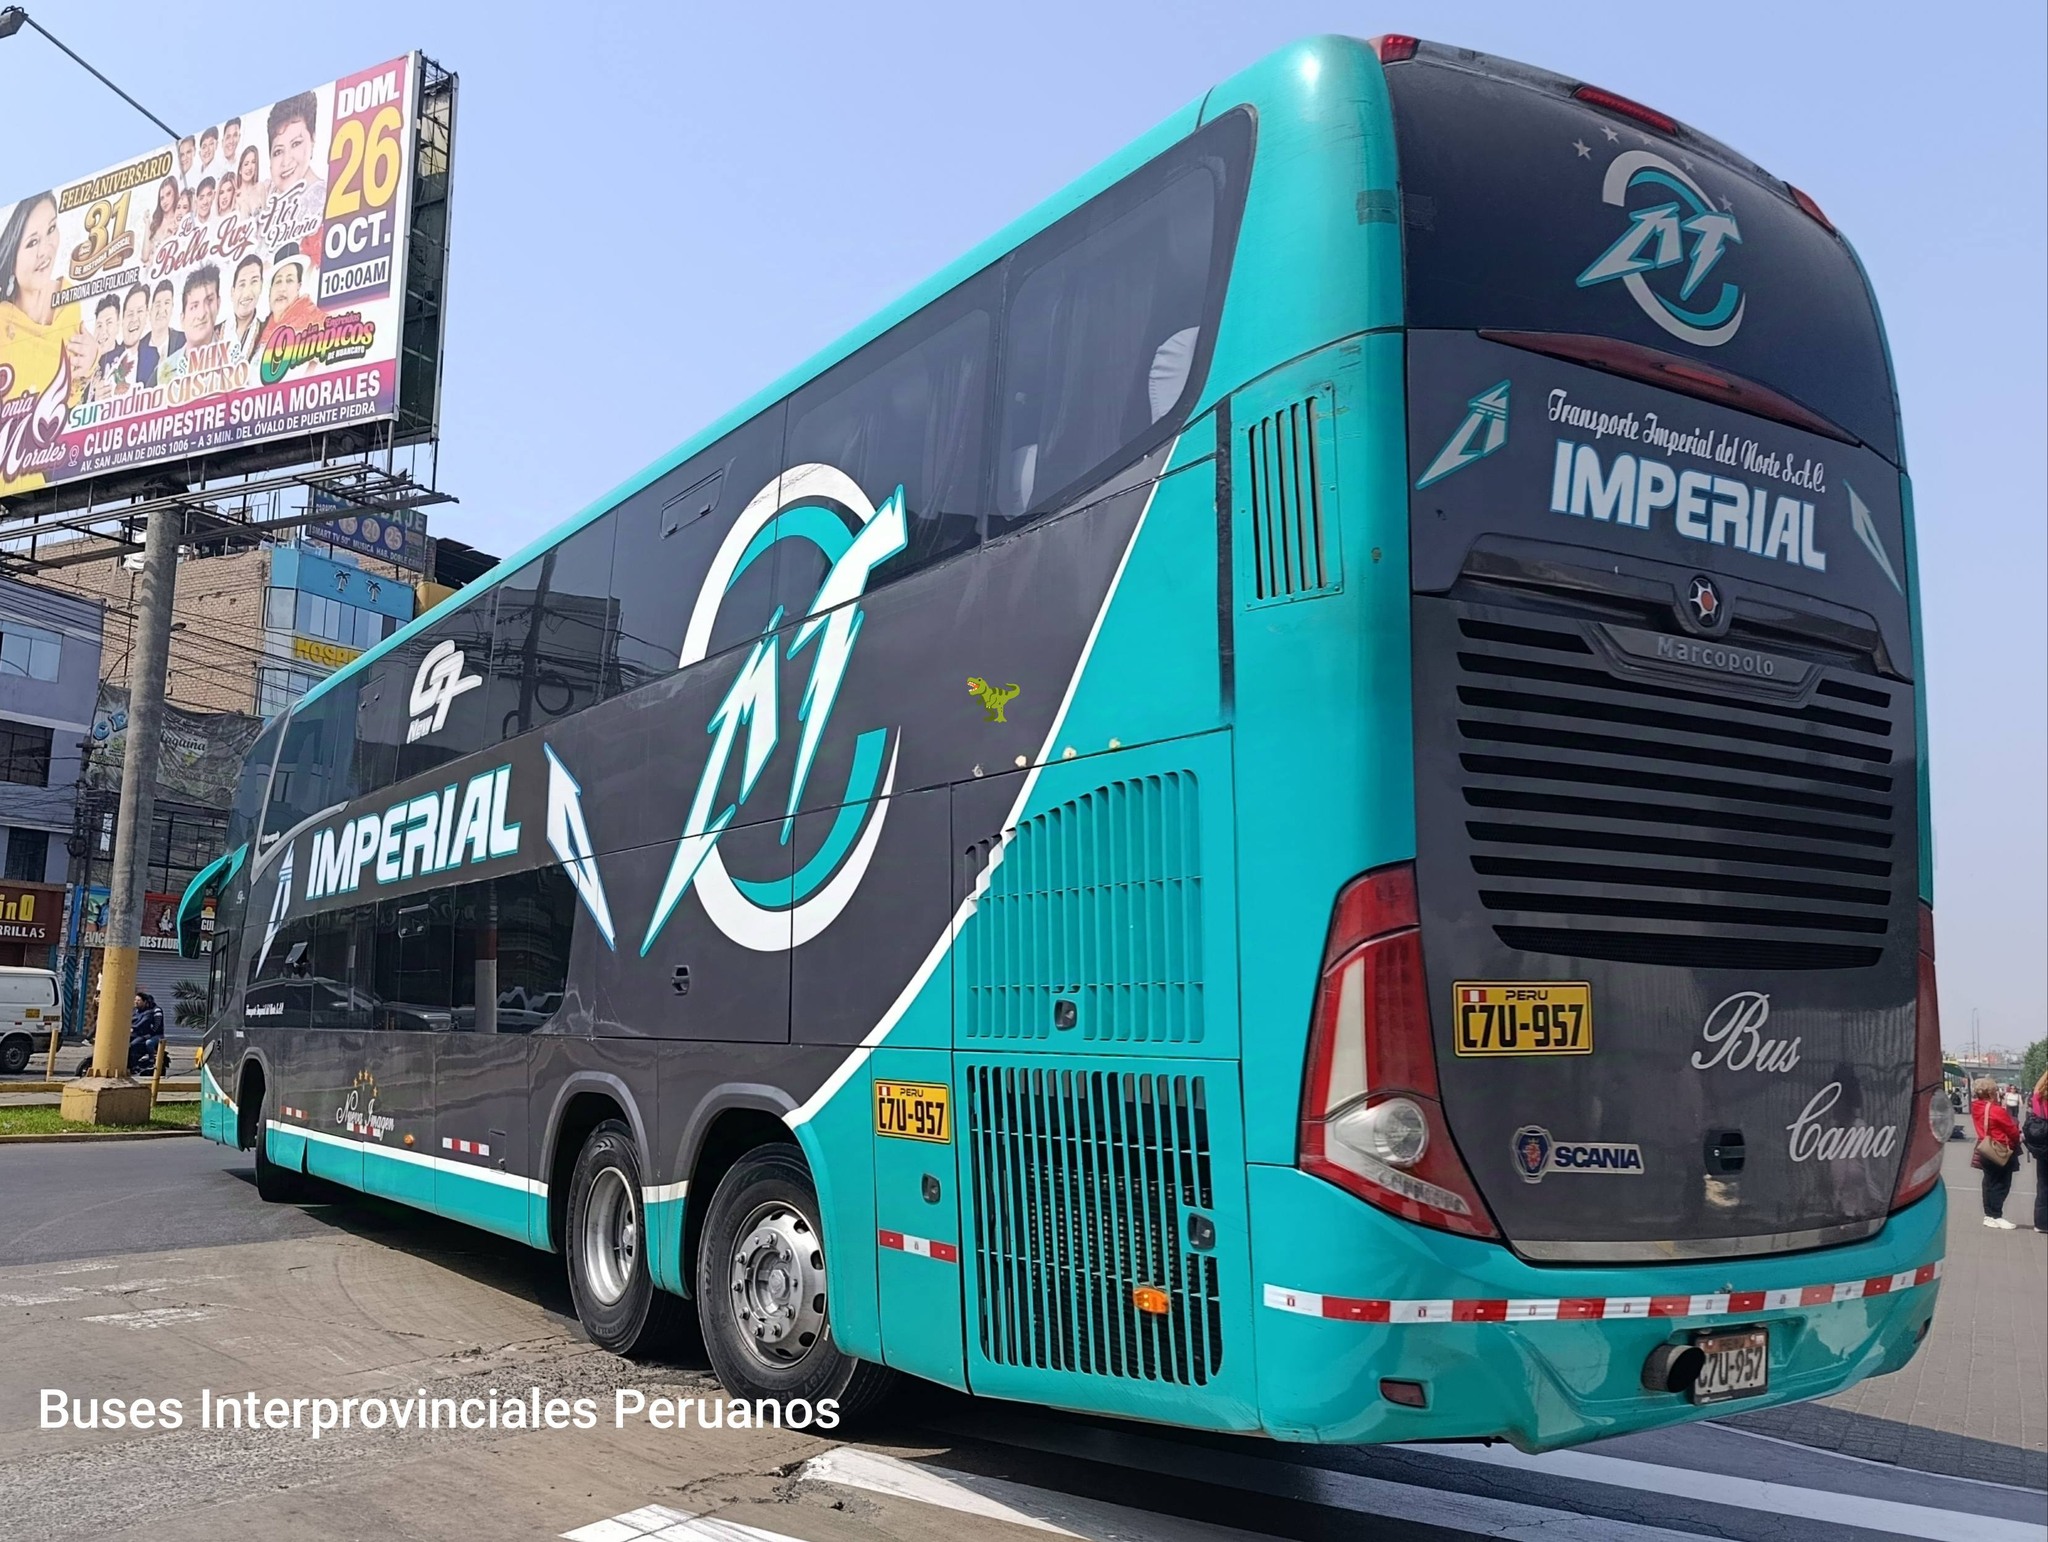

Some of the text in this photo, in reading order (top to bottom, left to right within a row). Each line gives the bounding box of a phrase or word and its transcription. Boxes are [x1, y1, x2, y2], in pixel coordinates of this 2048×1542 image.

[337, 70, 400, 121] DOM.
[60, 153, 172, 212] FELIZ ANIVERSARIO
[325, 106, 402, 220] 26
[84, 191, 132, 266] 31
[151, 214, 254, 279] Bella Luz
[325, 210, 391, 259] OCT.
[51, 268, 140, 308] LA PATRONA DEL FOLKLORE
[324, 265, 386, 294] 10:00AM
[188, 341, 233, 372] MAX
[167, 362, 249, 405] CASTRO
[80, 461, 93, 473] AV.
[94, 457, 111, 471] SAN
[112, 452, 134, 467] JUAN
[135, 449, 146, 461] DE
[147, 445, 167, 459] DIOS
[169, 441, 189, 455] 1006
[198, 436, 205, 448] A
[206, 435, 213, 447] 3
[214, 429, 234, 445] MIN.
[236, 425, 252, 440] DEL
[255, 416, 285, 437] ÓVALO
[287, 418, 299, 431] DE
[301, 410, 338, 428] PUENTE
[340, 402, 376, 420] PIEDRA
[84, 370, 381, 458] CLUB CAMPESTRE SONIA MORALES
[1548, 388, 1640, 440] Transporte
[1642, 412, 1714, 458] Imperial
[1715, 433, 1739, 466] del
[1740, 440, 1780, 479] Norte
[1550, 439, 1826, 573] IMPERIAL
[1657, 636, 1774, 675] Marcopolo
[406, 715, 433, 744] New
[305, 764, 522, 901] IMPERIAL
[1505, 989, 1548, 1000] PERU
[1462, 1004, 1584, 1048] C7U-957
[1691, 991, 1801, 1073] Bus
[878, 1097, 945, 1135] C7U-957
[900, 1088, 924, 1097] PERU
[1785, 1082, 1896, 1162] Cama
[1554, 1146, 1642, 1169] SCANIA
